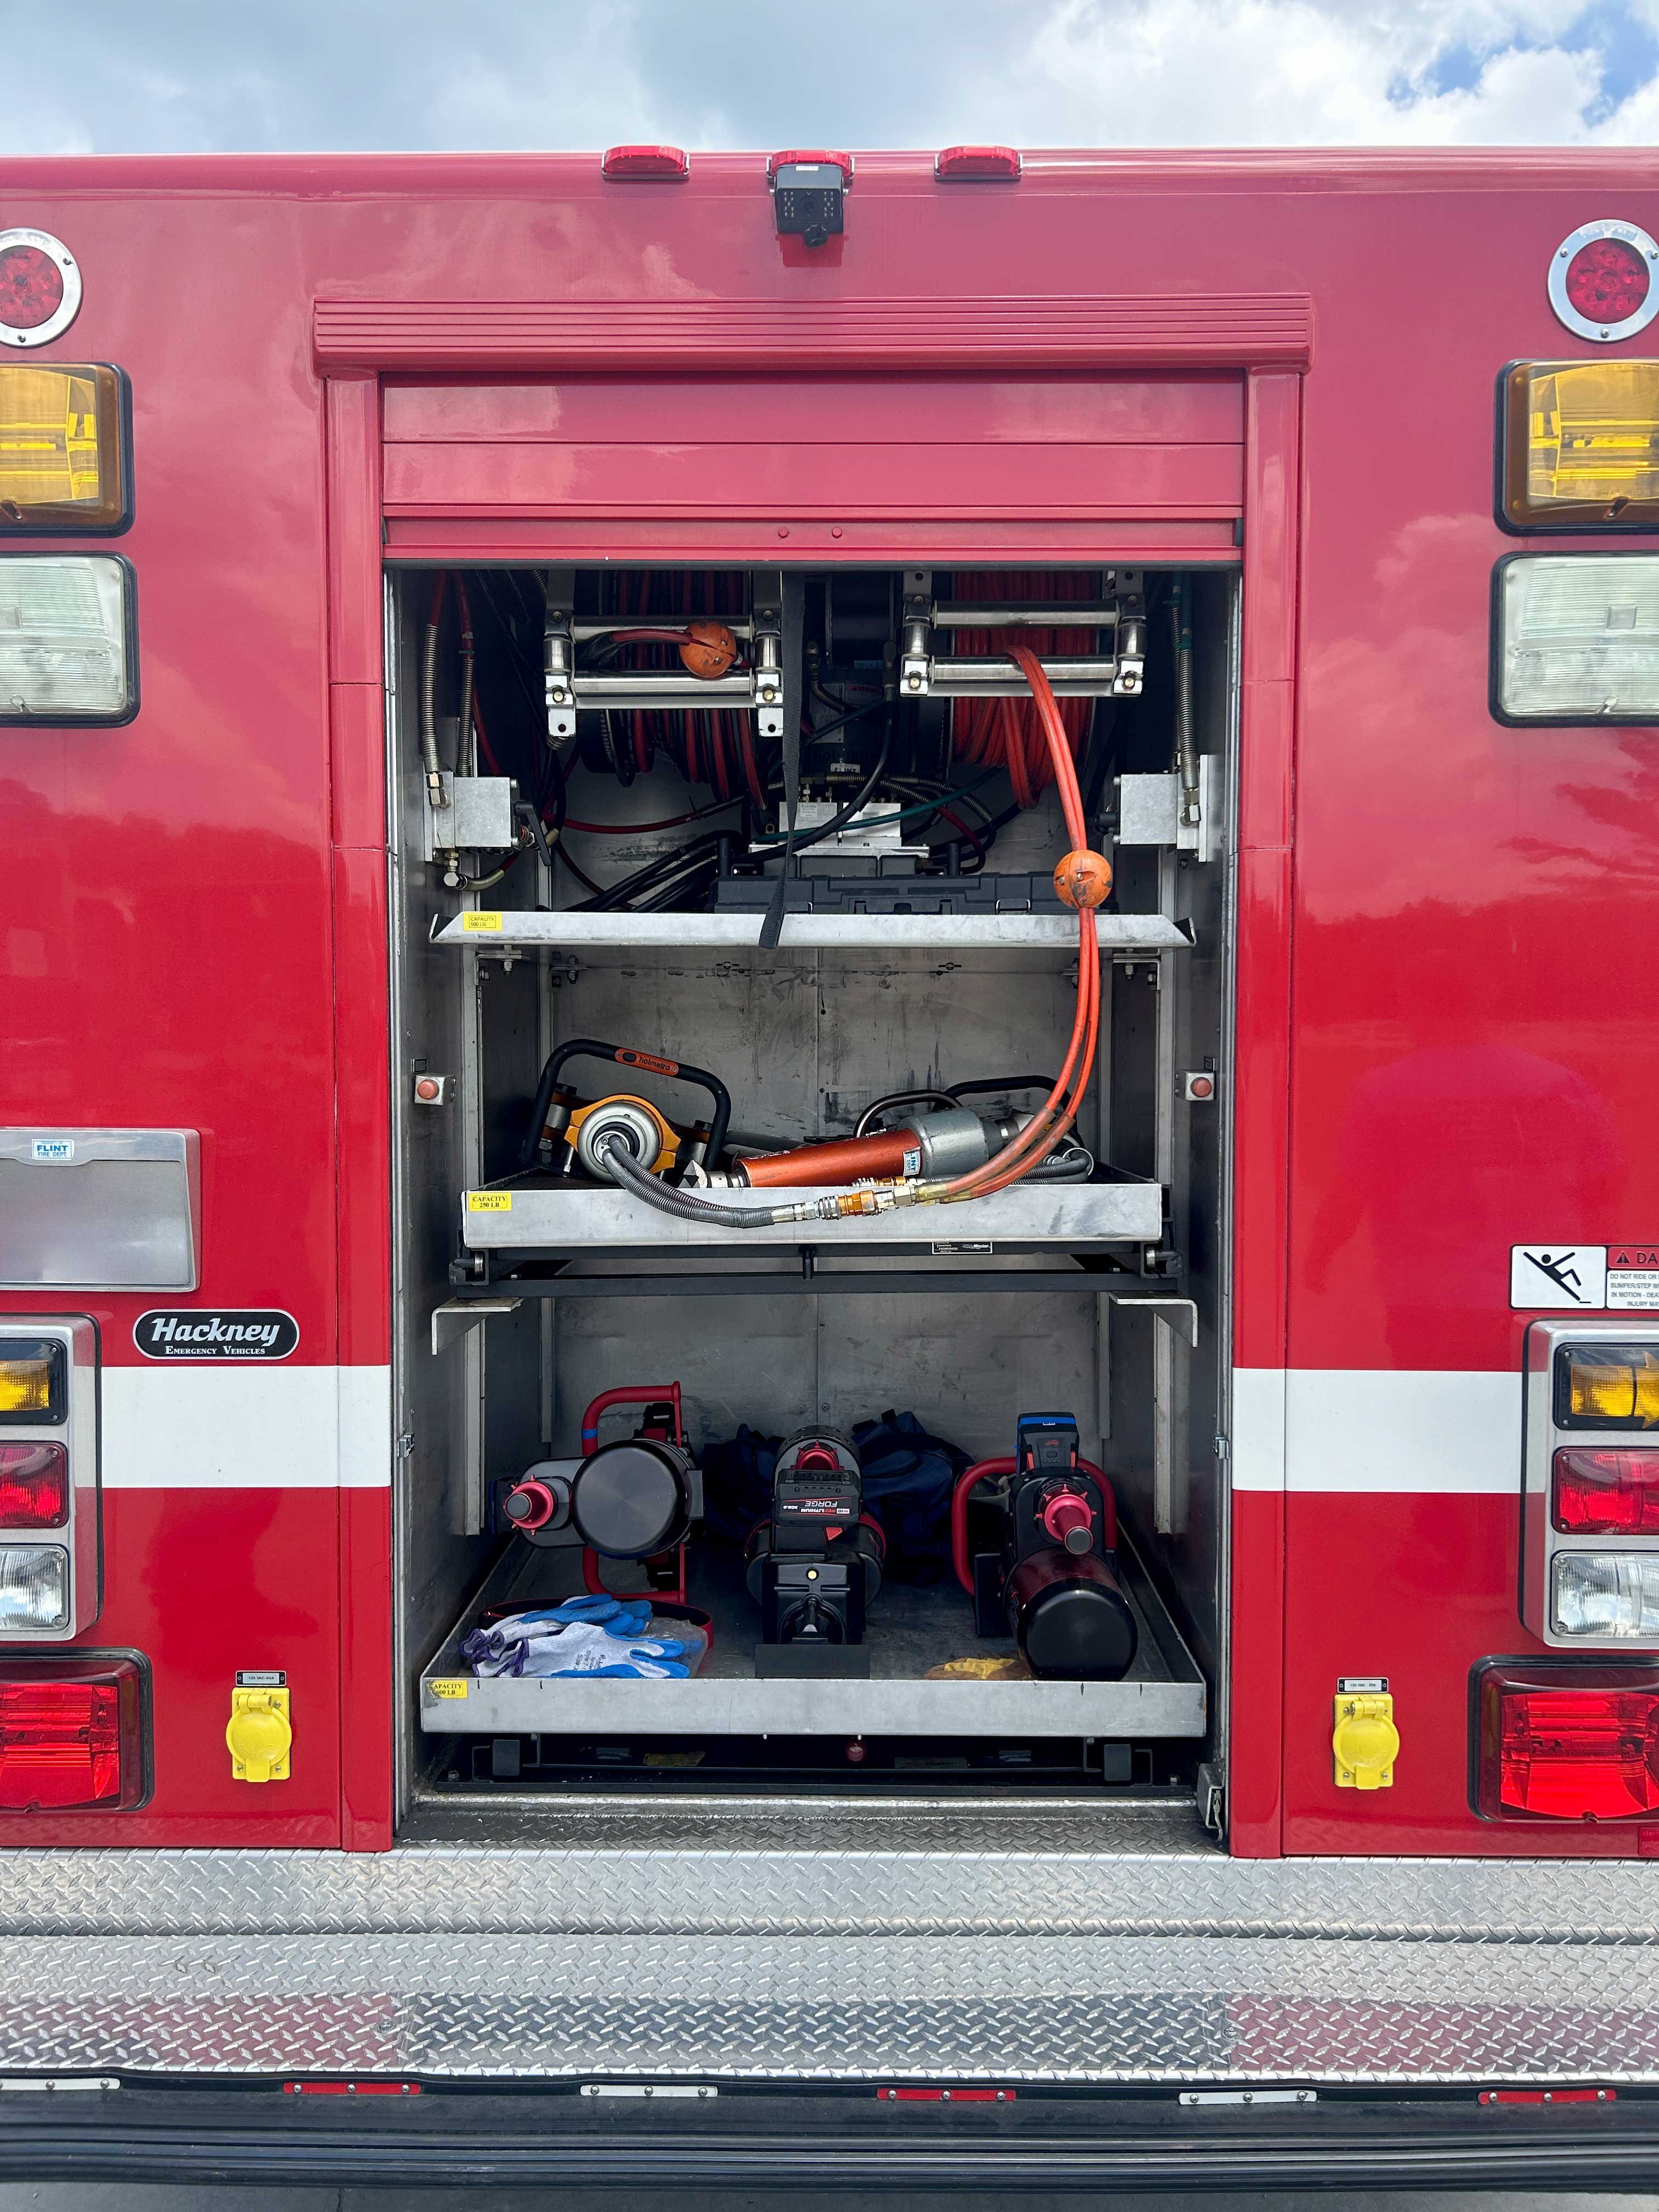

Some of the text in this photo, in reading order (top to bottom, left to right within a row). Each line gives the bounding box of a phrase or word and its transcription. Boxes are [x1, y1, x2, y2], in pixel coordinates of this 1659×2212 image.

[639, 1056, 670, 1070] holmatro
[1637, 1251, 1659, 1263] DA
[151, 1318, 281, 1347] Hackney
[165, 1345, 266, 1355] EMERGENCY VEHICLES
